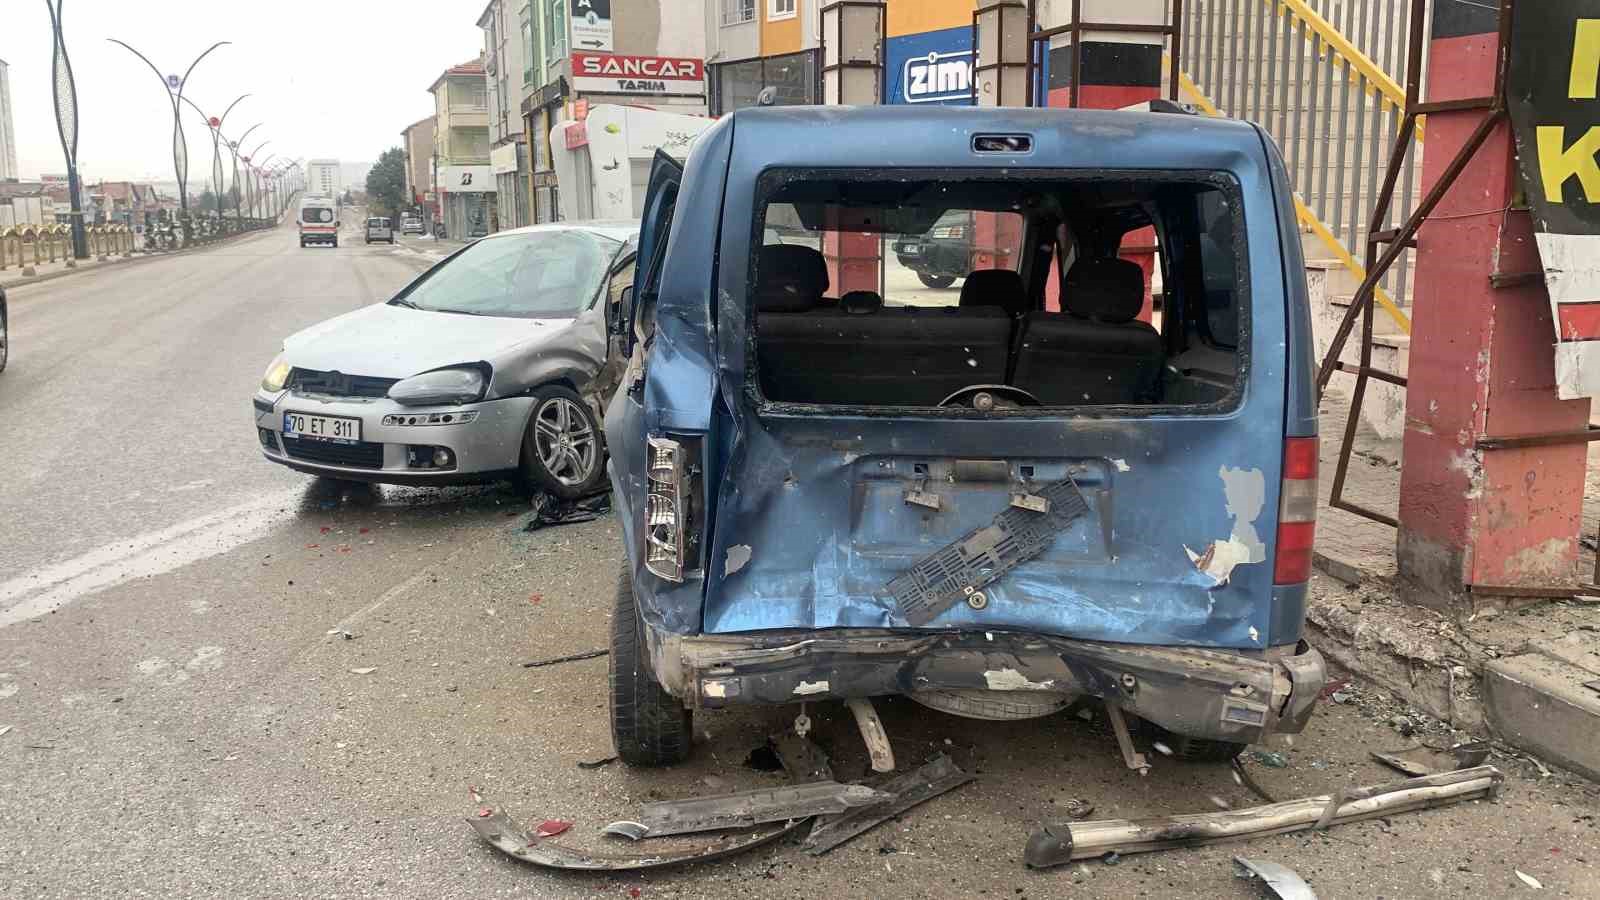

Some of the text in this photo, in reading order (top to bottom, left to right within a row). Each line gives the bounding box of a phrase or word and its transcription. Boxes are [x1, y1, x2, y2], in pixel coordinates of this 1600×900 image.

[582, 56, 696, 77] SANCAR
[617, 79, 666, 92] TARIM
[291, 416, 352, 437] 70 ET 311
